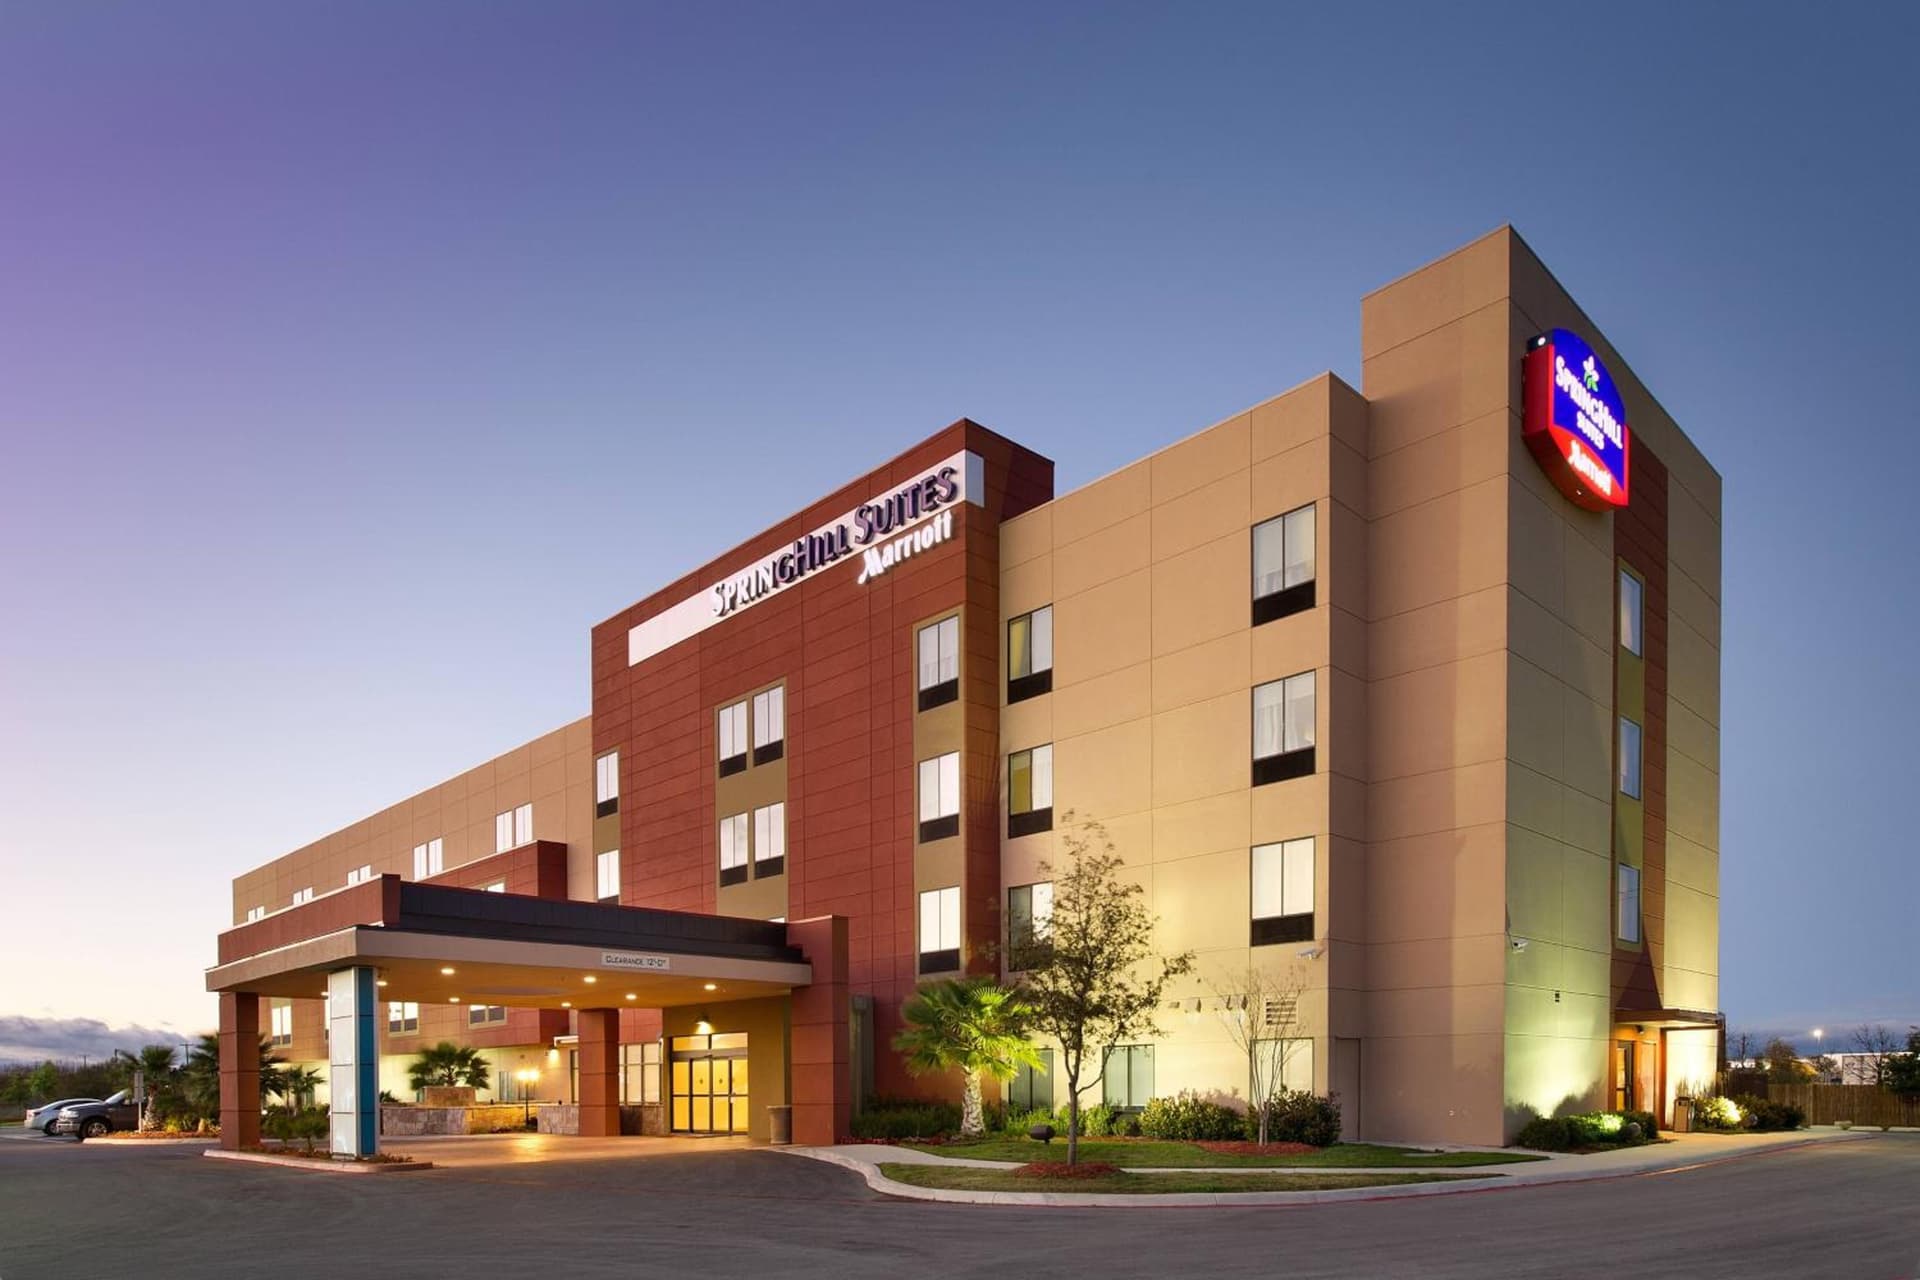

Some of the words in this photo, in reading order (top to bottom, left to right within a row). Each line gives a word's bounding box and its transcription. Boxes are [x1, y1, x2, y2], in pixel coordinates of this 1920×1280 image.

[712, 523, 852, 617] SPRINGHILL
[854, 466, 958, 545] SUITES
[857, 510, 953, 584] Marriott
[605, 955, 644, 966] CLEARANCE
